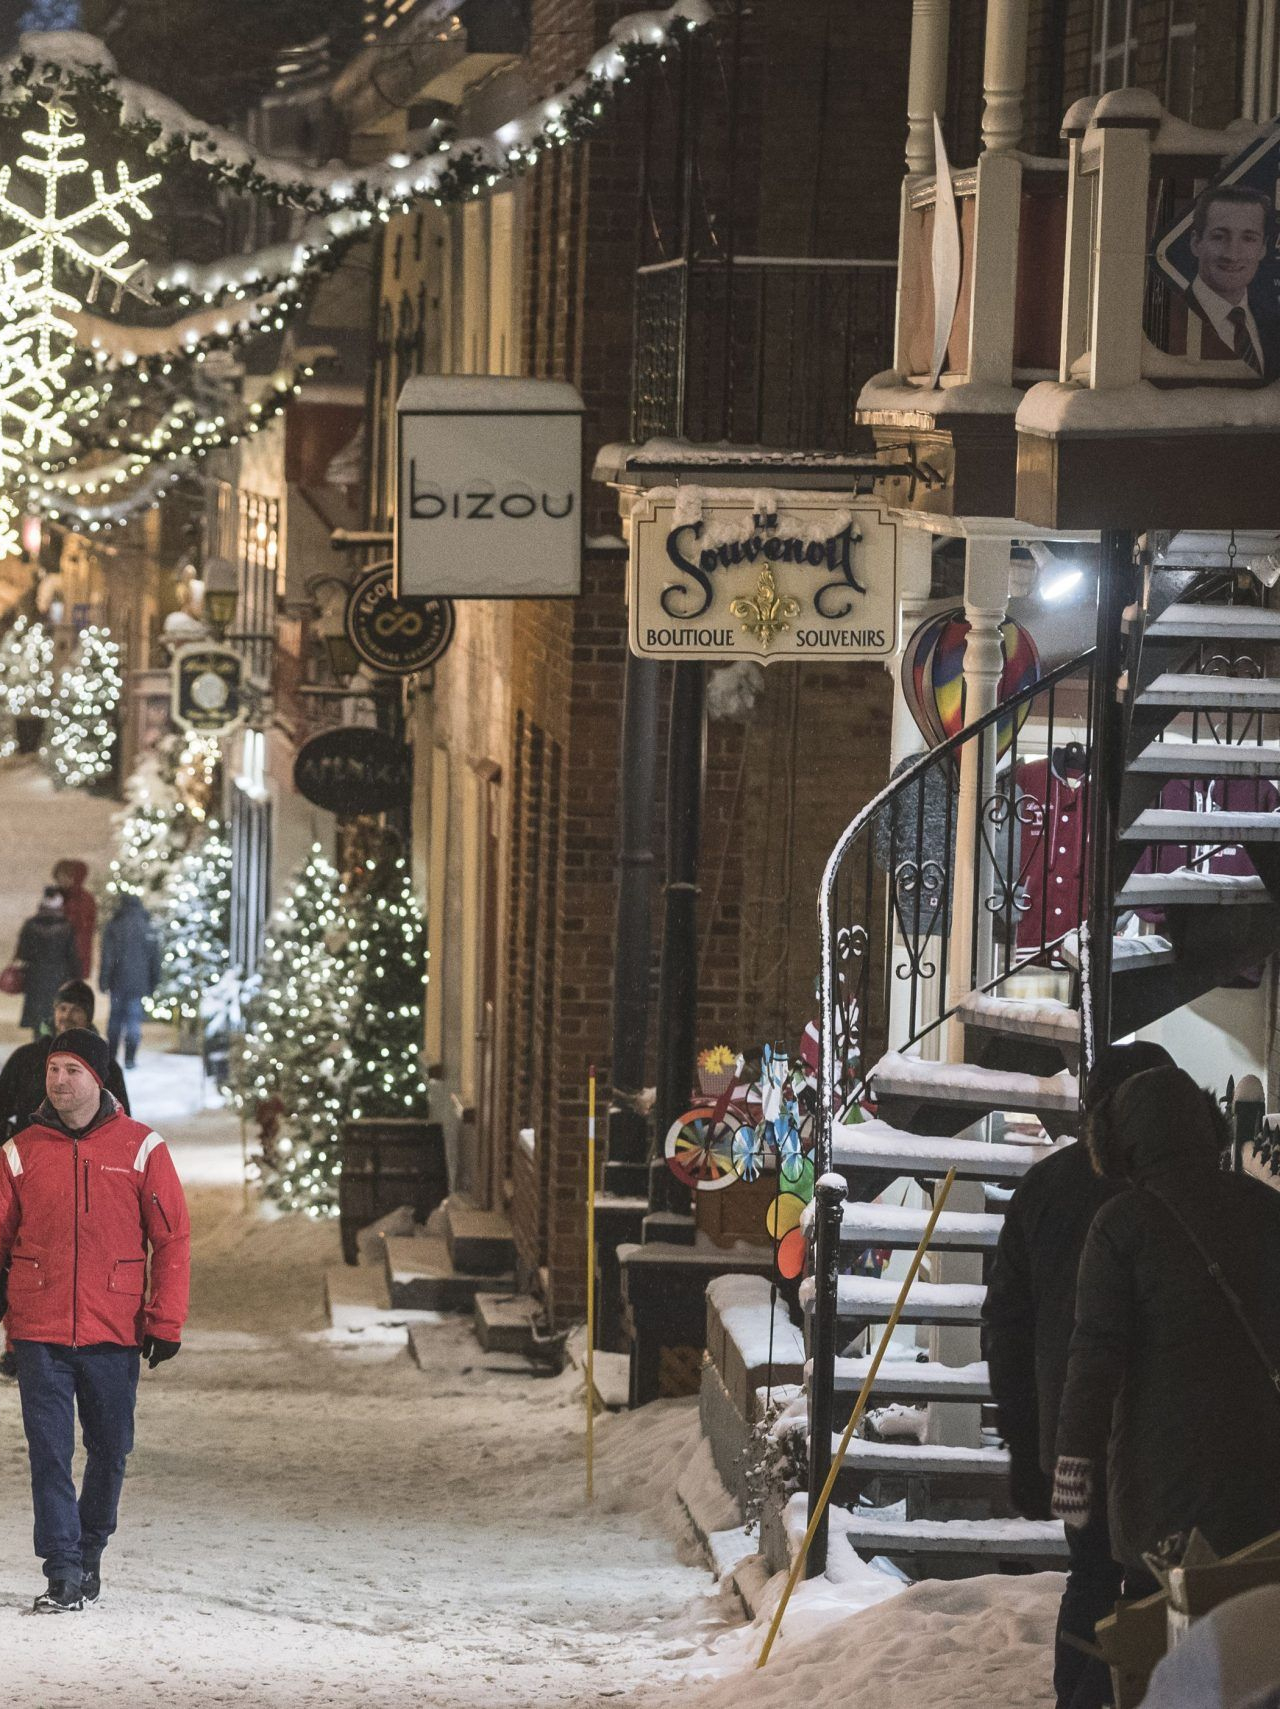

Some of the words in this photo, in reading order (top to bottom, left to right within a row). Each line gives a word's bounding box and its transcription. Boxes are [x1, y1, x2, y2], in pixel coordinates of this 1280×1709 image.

[409, 459, 574, 519] bizou
[647, 629, 734, 647] BOUTIQUE
[796, 629, 885, 648] SOUVENIRS
